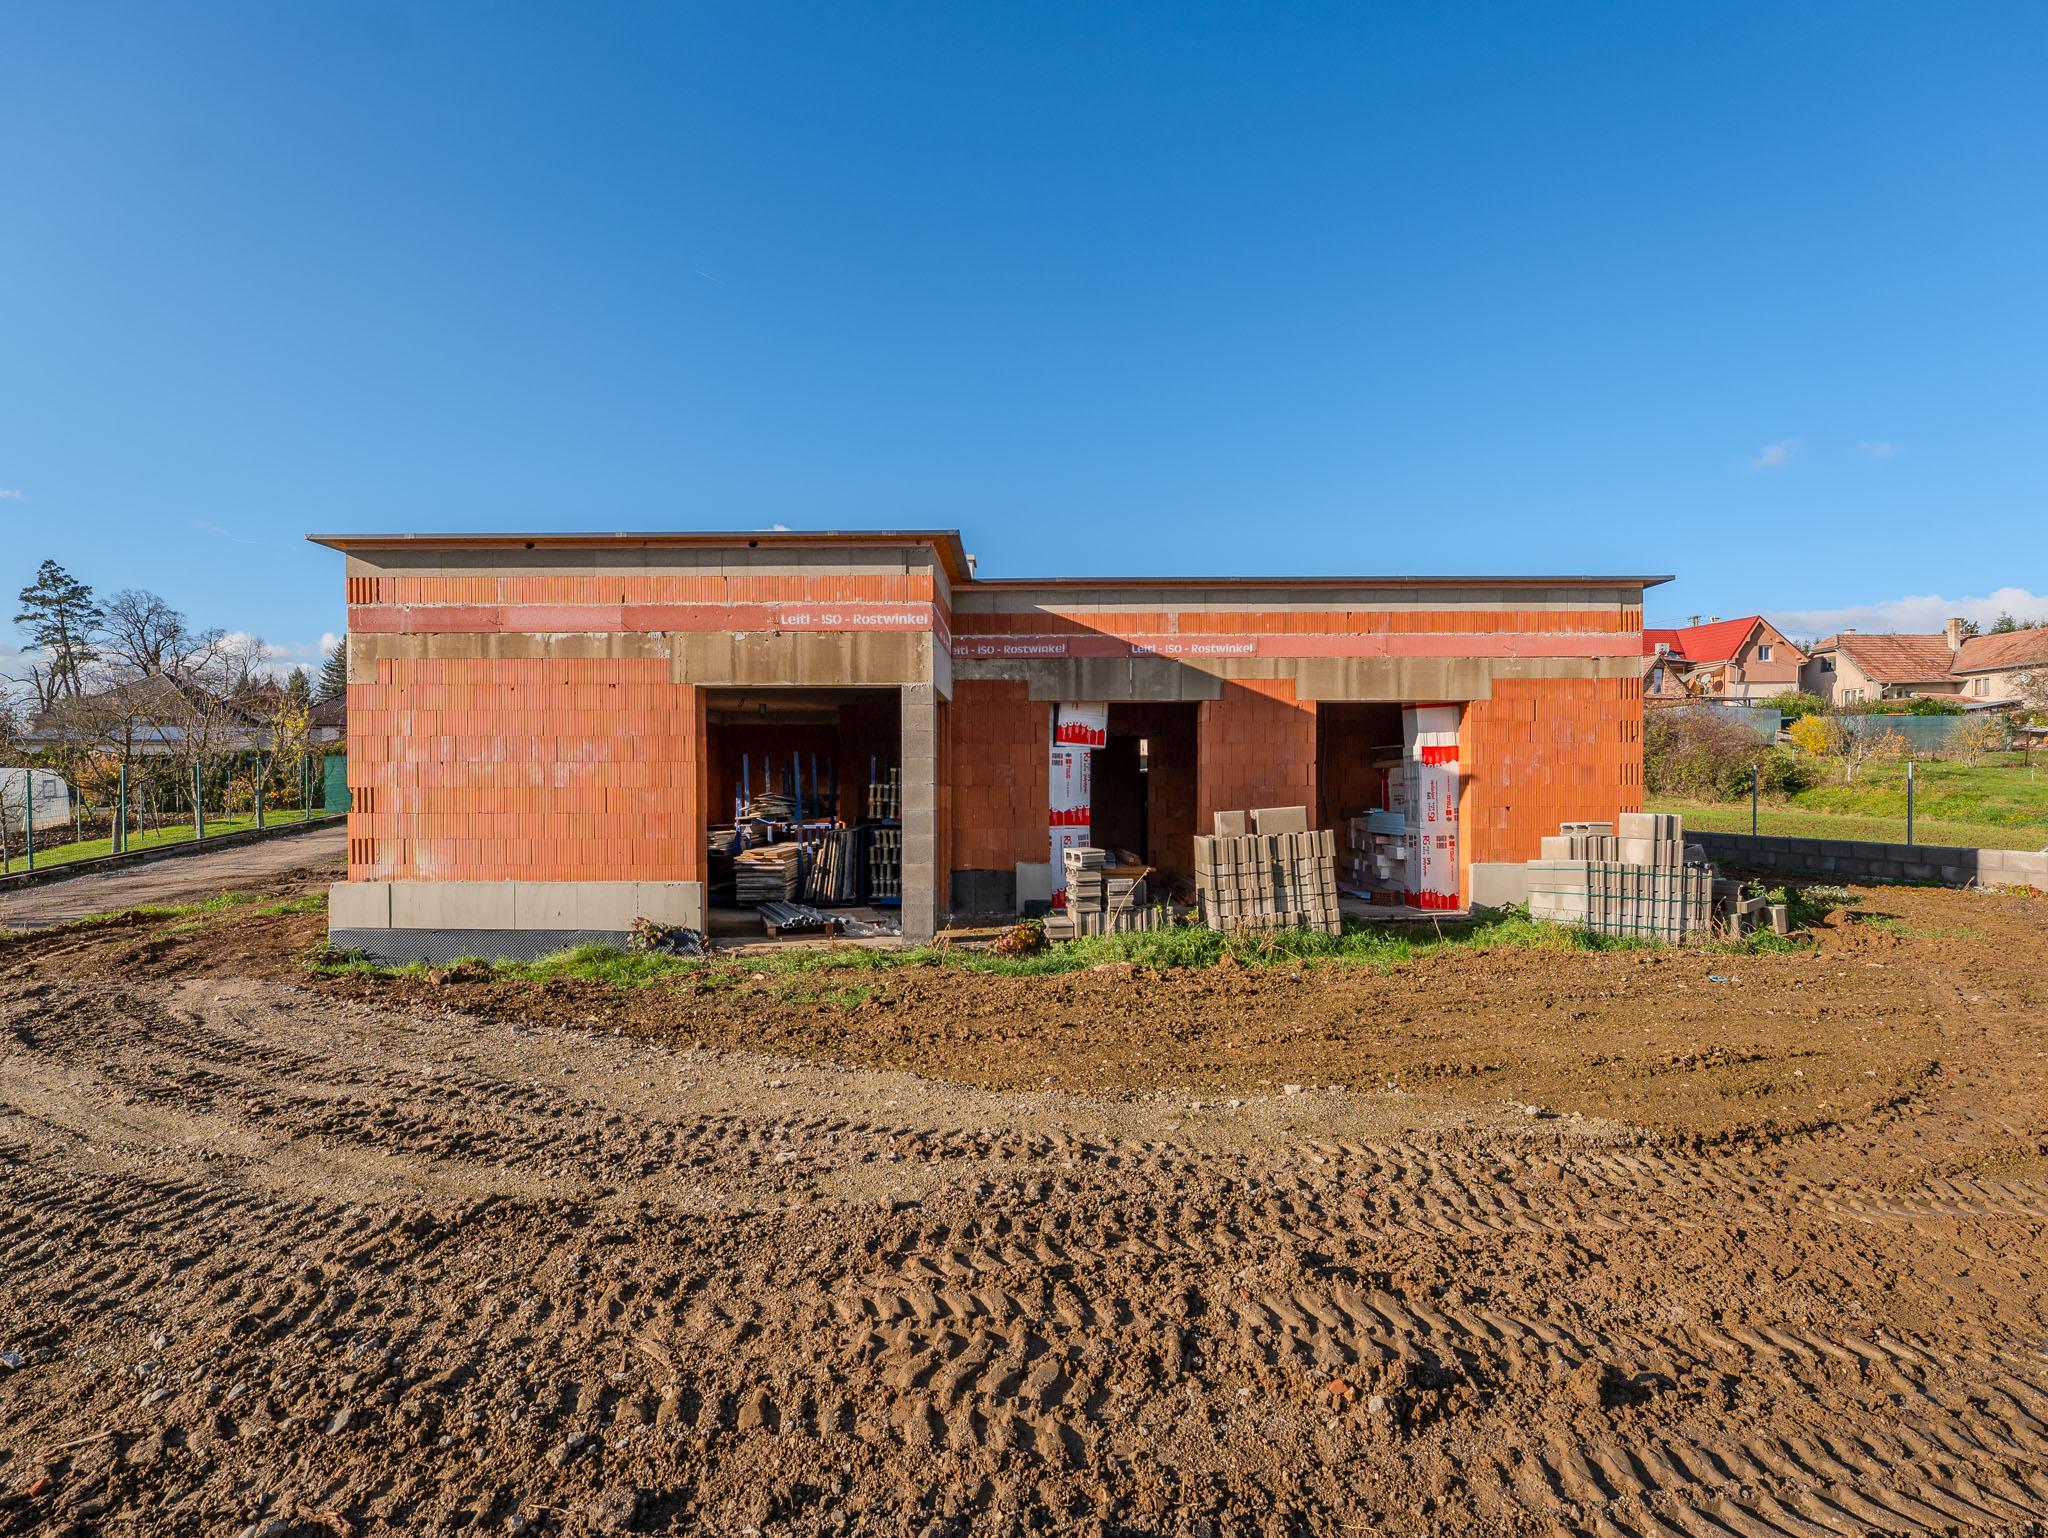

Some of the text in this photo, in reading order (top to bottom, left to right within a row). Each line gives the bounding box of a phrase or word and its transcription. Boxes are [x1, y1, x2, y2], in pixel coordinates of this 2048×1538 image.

[780, 614, 810, 624] Leitl
[821, 614, 842, 624] ISO
[853, 613, 929, 624] Rostwinkel
[952, 645, 968, 655] eitl
[978, 645, 994, 654] ISO
[1003, 643, 1065, 654] Rostwinkel
[1131, 643, 1156, 653] Leitl
[1165, 644, 1182, 653] ISO
[1191, 643, 1254, 653] Rostwinkel
